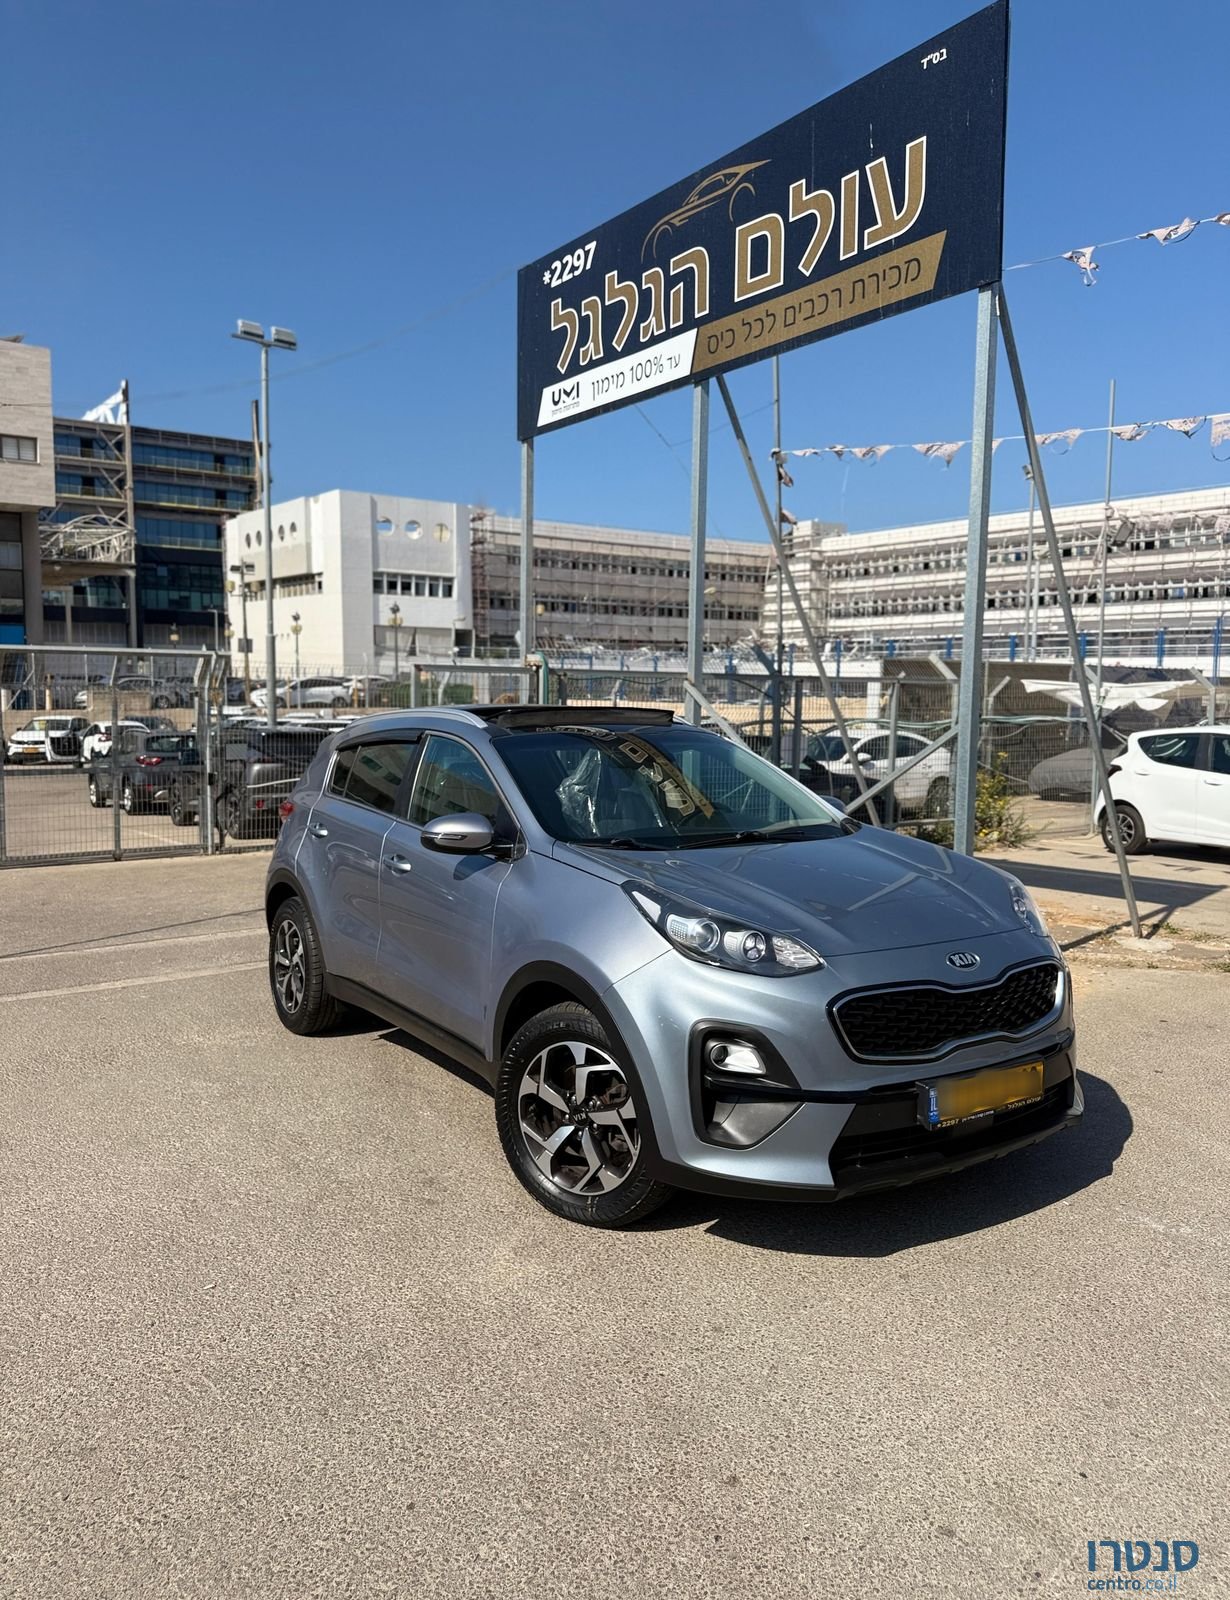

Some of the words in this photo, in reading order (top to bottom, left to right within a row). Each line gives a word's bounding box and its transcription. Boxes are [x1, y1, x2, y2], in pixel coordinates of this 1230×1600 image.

[734, 135, 927, 302] עולם
[849, 257, 921, 304] מכירת
[550, 246, 709, 373] הגלגל
[783, 287, 842, 328] רכבים
[742, 309, 776, 342] לכל
[707, 328, 735, 354] כיס
[629, 354, 664, 384] 100%
[666, 353, 681, 369] עד
[552, 381, 579, 406] UMI
[591, 371, 625, 401] מימון
[950, 953, 976, 966] KIA
